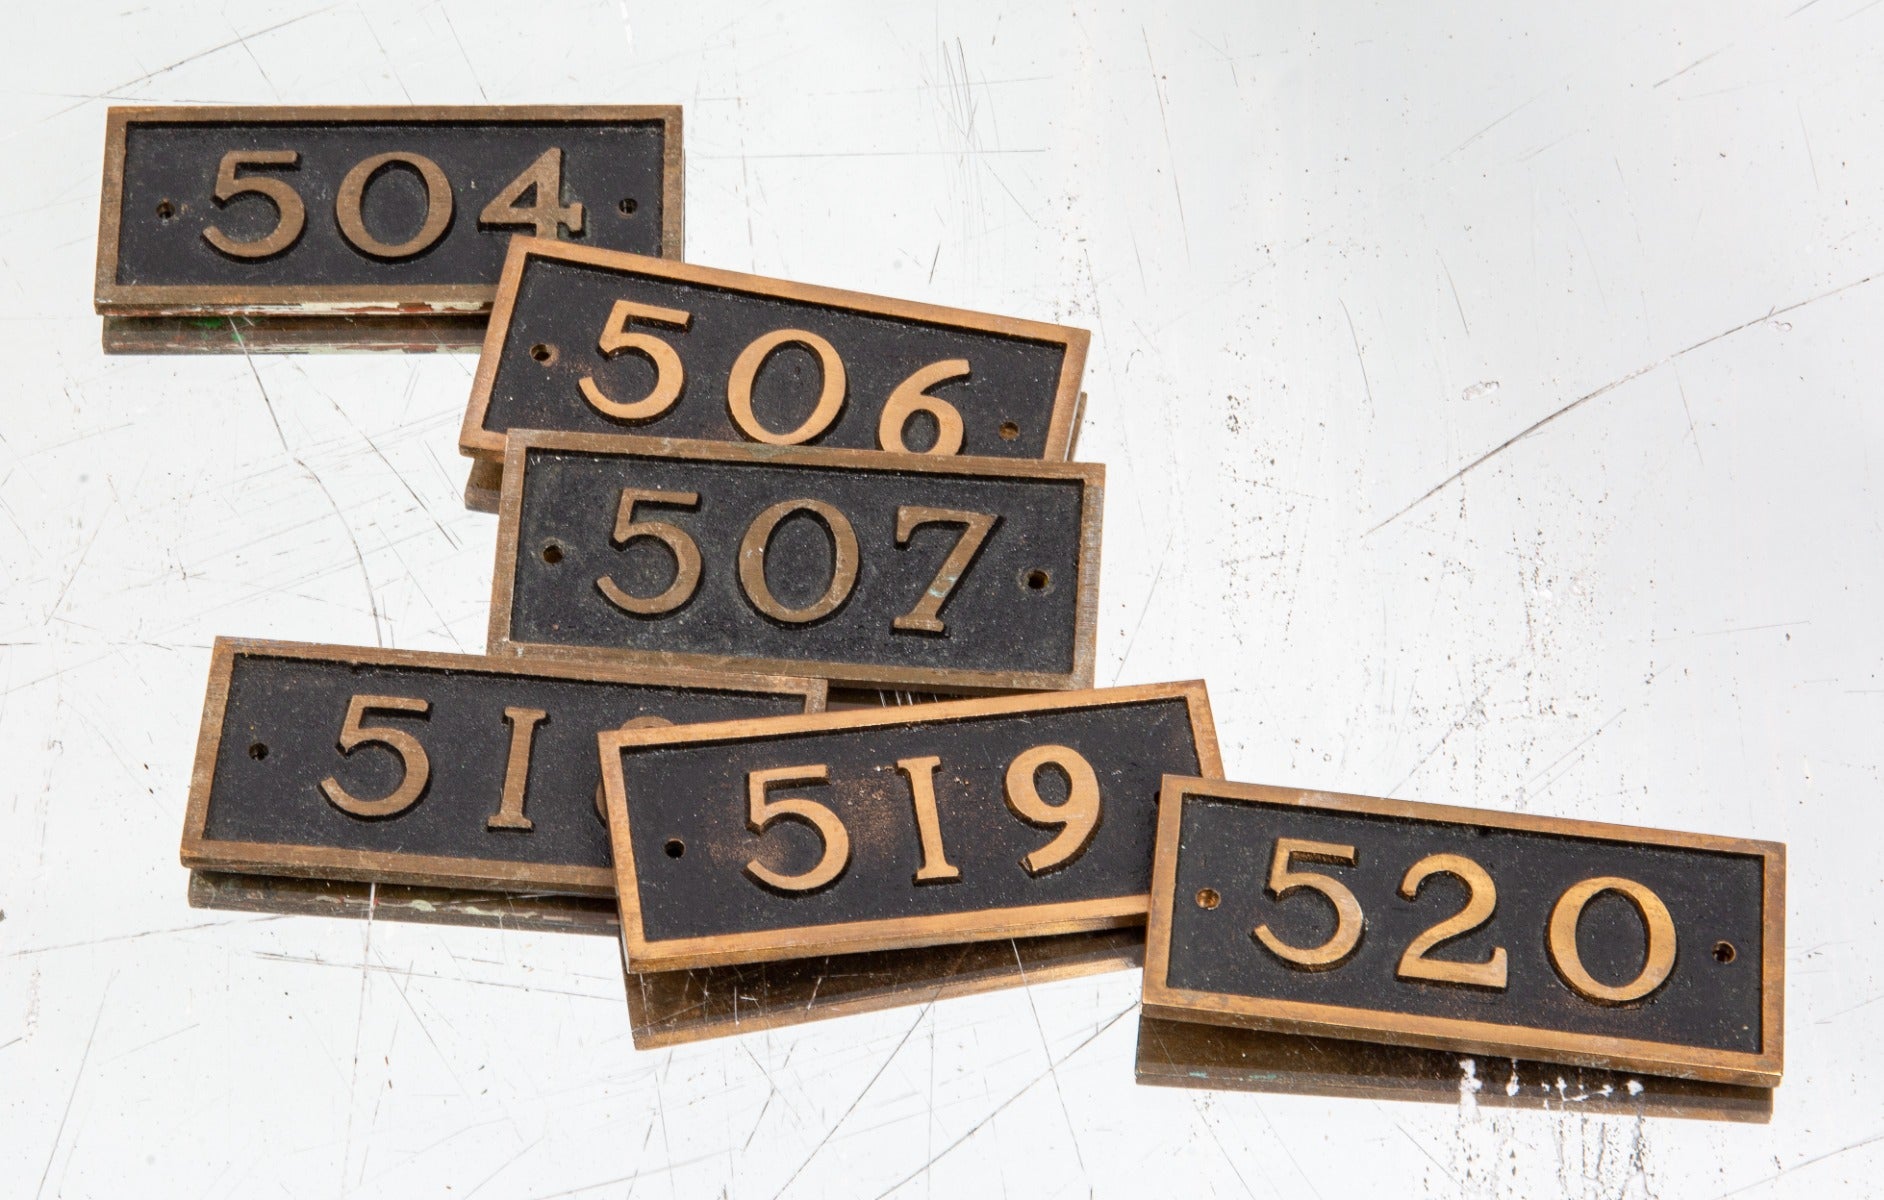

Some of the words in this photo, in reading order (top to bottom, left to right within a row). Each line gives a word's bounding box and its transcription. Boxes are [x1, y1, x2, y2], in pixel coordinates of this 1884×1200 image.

[201, 147, 583, 258] 504
[578, 300, 971, 455] 506
[597, 488, 1000, 632] 507
[319, 694, 674, 830] 51
[745, 745, 1100, 891] 519
[1253, 838, 1677, 1002] 520
